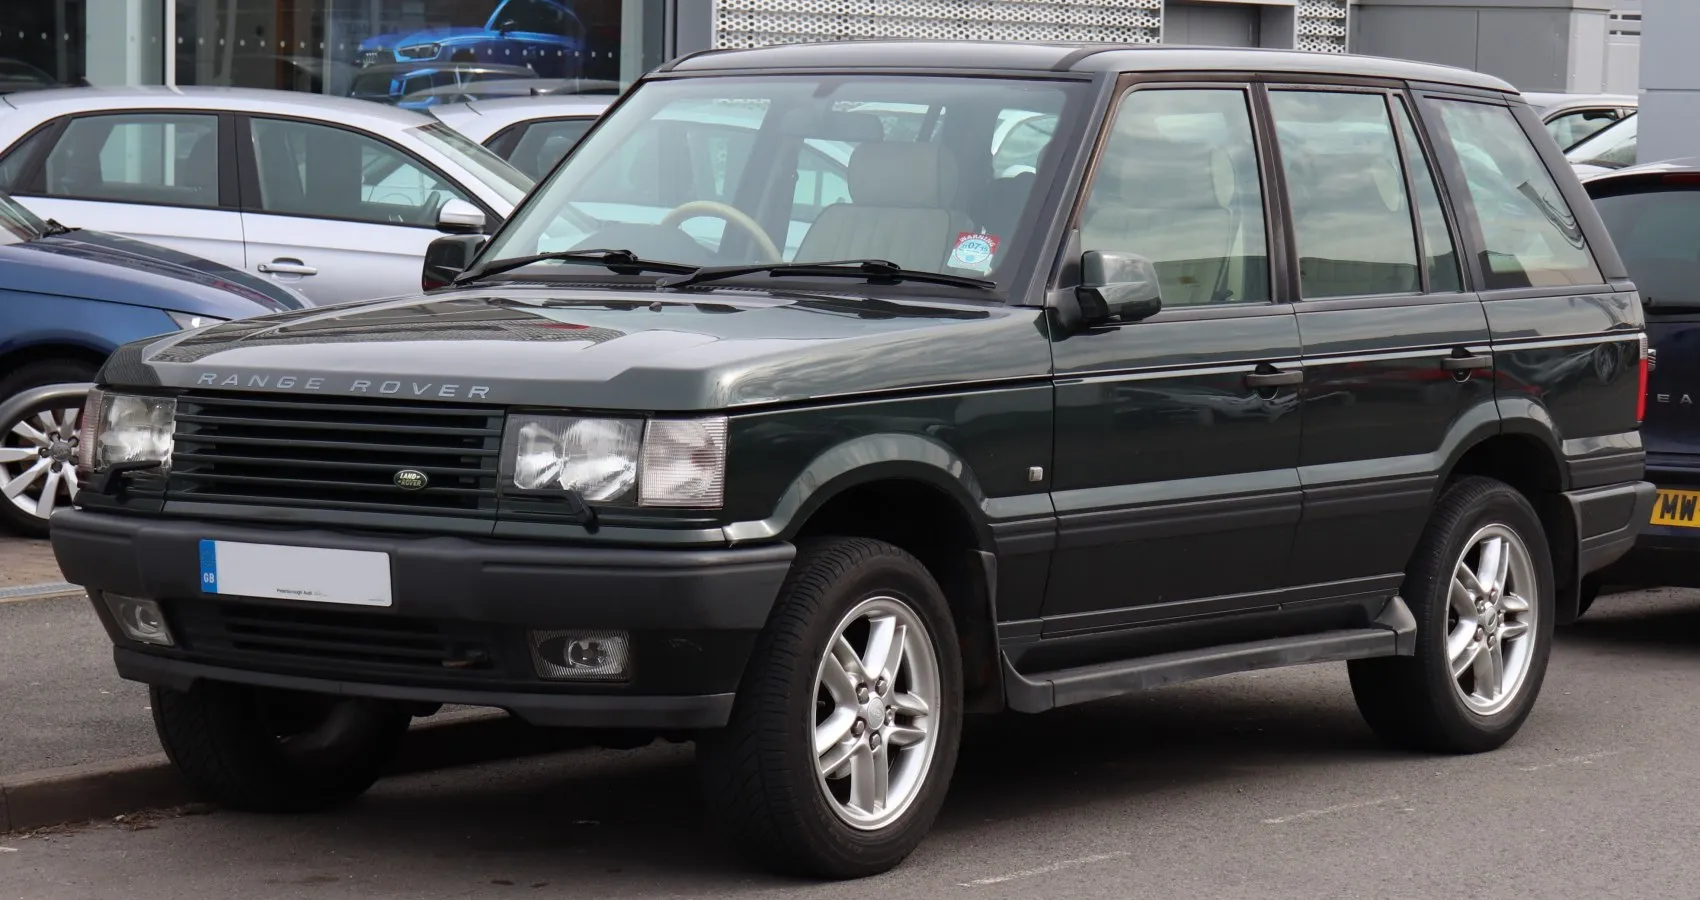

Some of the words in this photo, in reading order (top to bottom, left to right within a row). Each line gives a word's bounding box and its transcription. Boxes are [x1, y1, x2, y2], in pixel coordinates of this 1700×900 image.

[959, 234, 996, 247] WARNING
[197, 373, 325, 390] RANGE
[349, 380, 490, 399] ROVER
[1656, 393, 1694, 404] EA
[203, 572, 215, 584] GB
